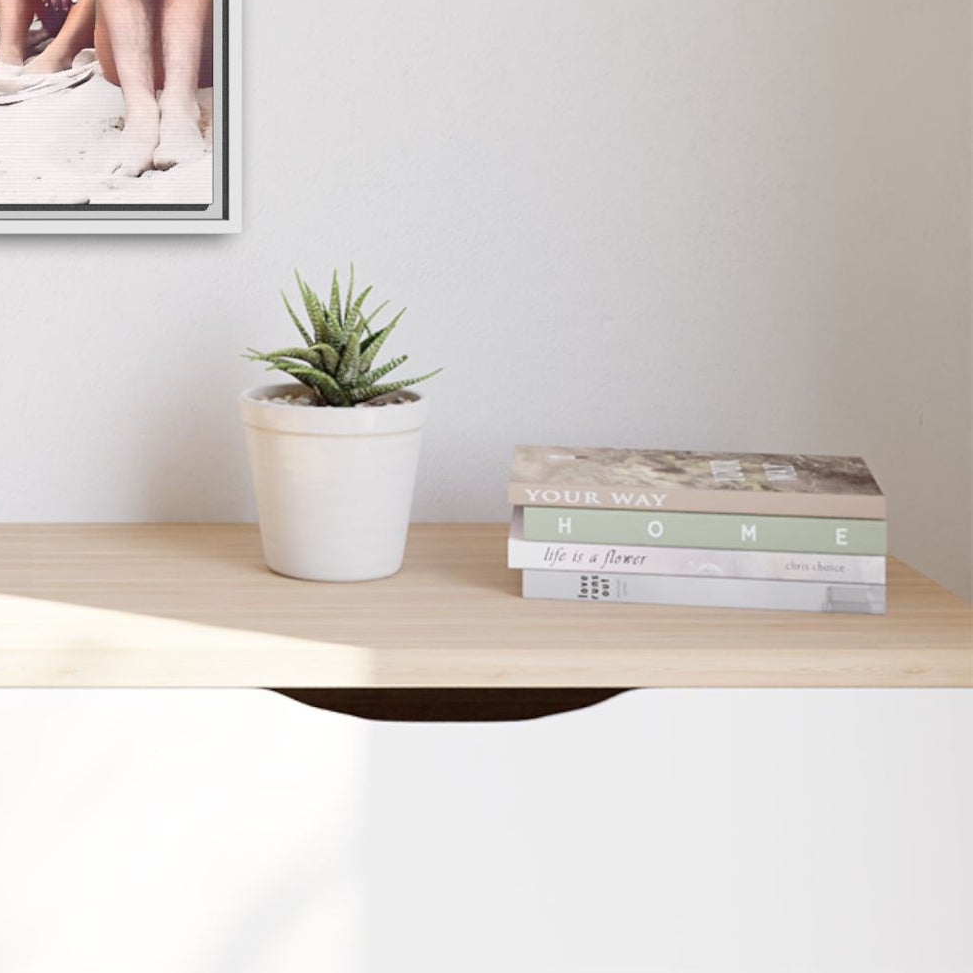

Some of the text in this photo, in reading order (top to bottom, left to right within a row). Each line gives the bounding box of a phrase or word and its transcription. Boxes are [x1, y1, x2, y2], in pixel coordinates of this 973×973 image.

[525, 489, 667, 507] YOUR WAY
[543, 546, 648, 569] life is a flower
[785, 559, 809, 572] chris
[578, 575, 588, 598] love
[591, 575, 599, 600] runs
[601, 578, 609, 597] out
